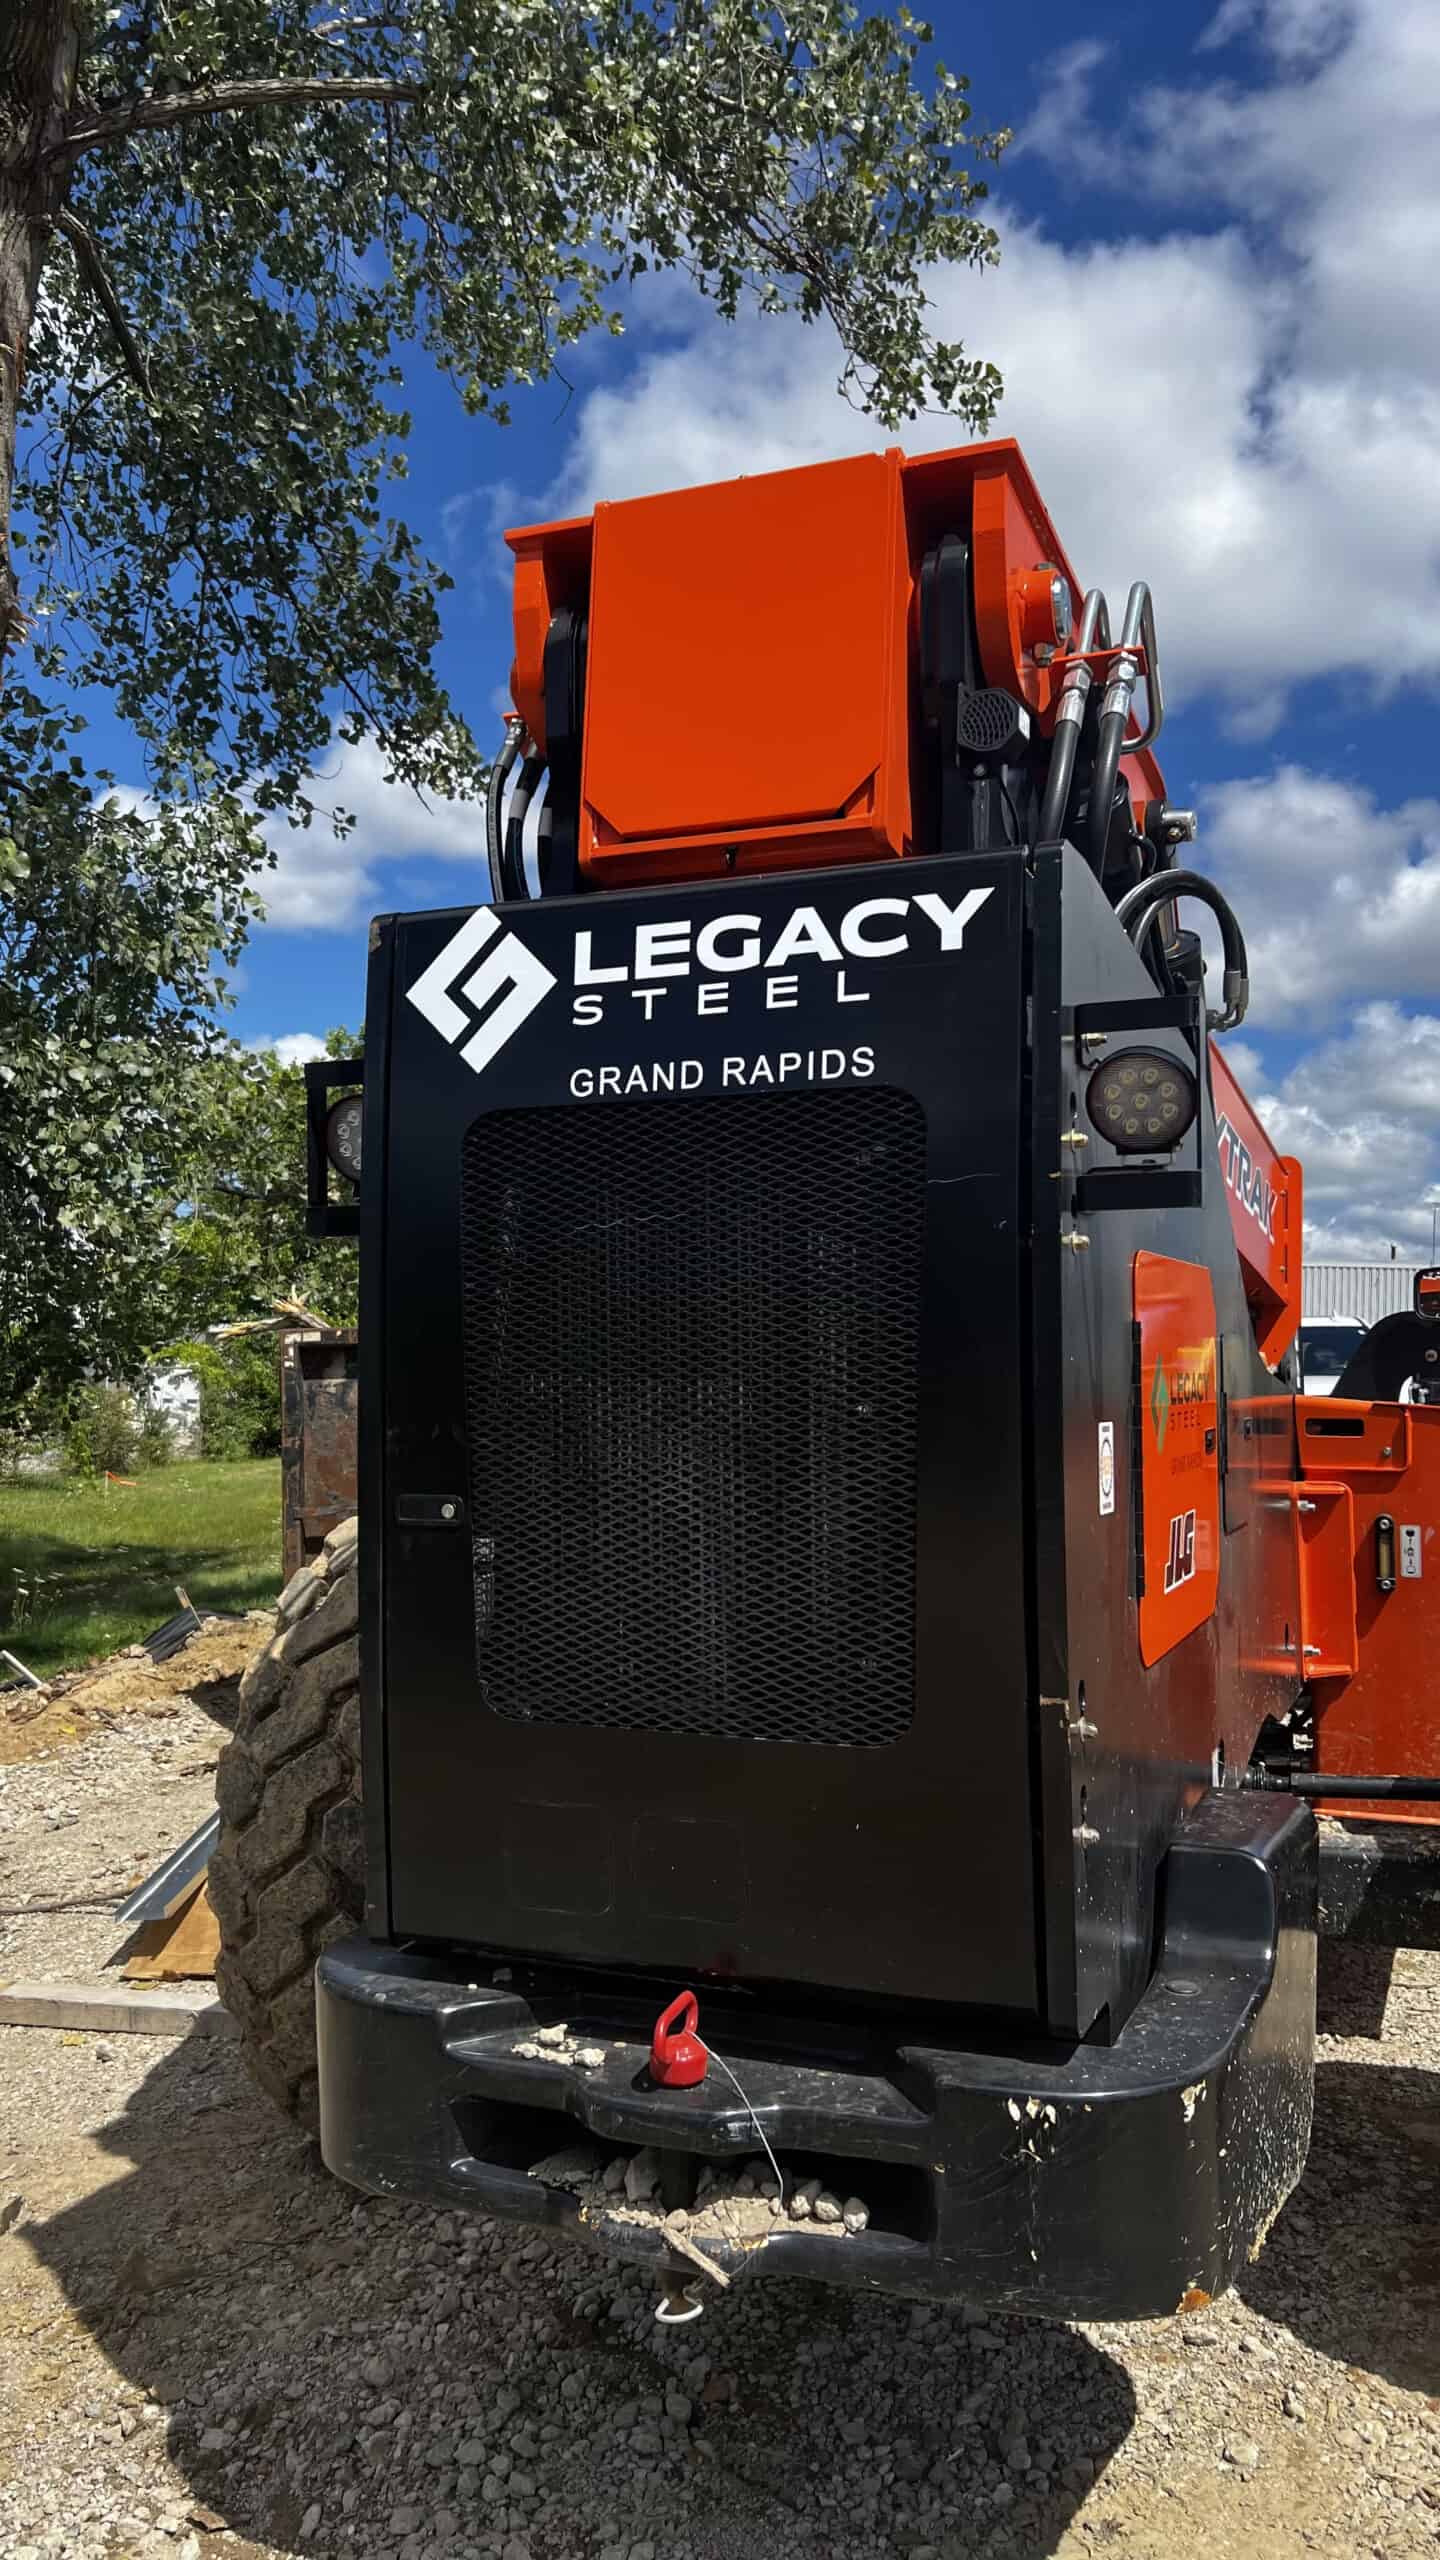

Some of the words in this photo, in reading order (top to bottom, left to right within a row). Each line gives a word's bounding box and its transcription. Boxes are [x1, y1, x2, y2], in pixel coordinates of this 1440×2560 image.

[573, 886, 995, 986] LEGACY
[572, 970, 870, 1026] STEEL
[569, 1059, 704, 1098] GRAND
[722, 1046, 875, 1087] RAPIDS
[1169, 1370, 1210, 1405] LEGACY
[1170, 1408, 1202, 1432] STEEL
[1164, 1508, 1196, 1595] JLG
